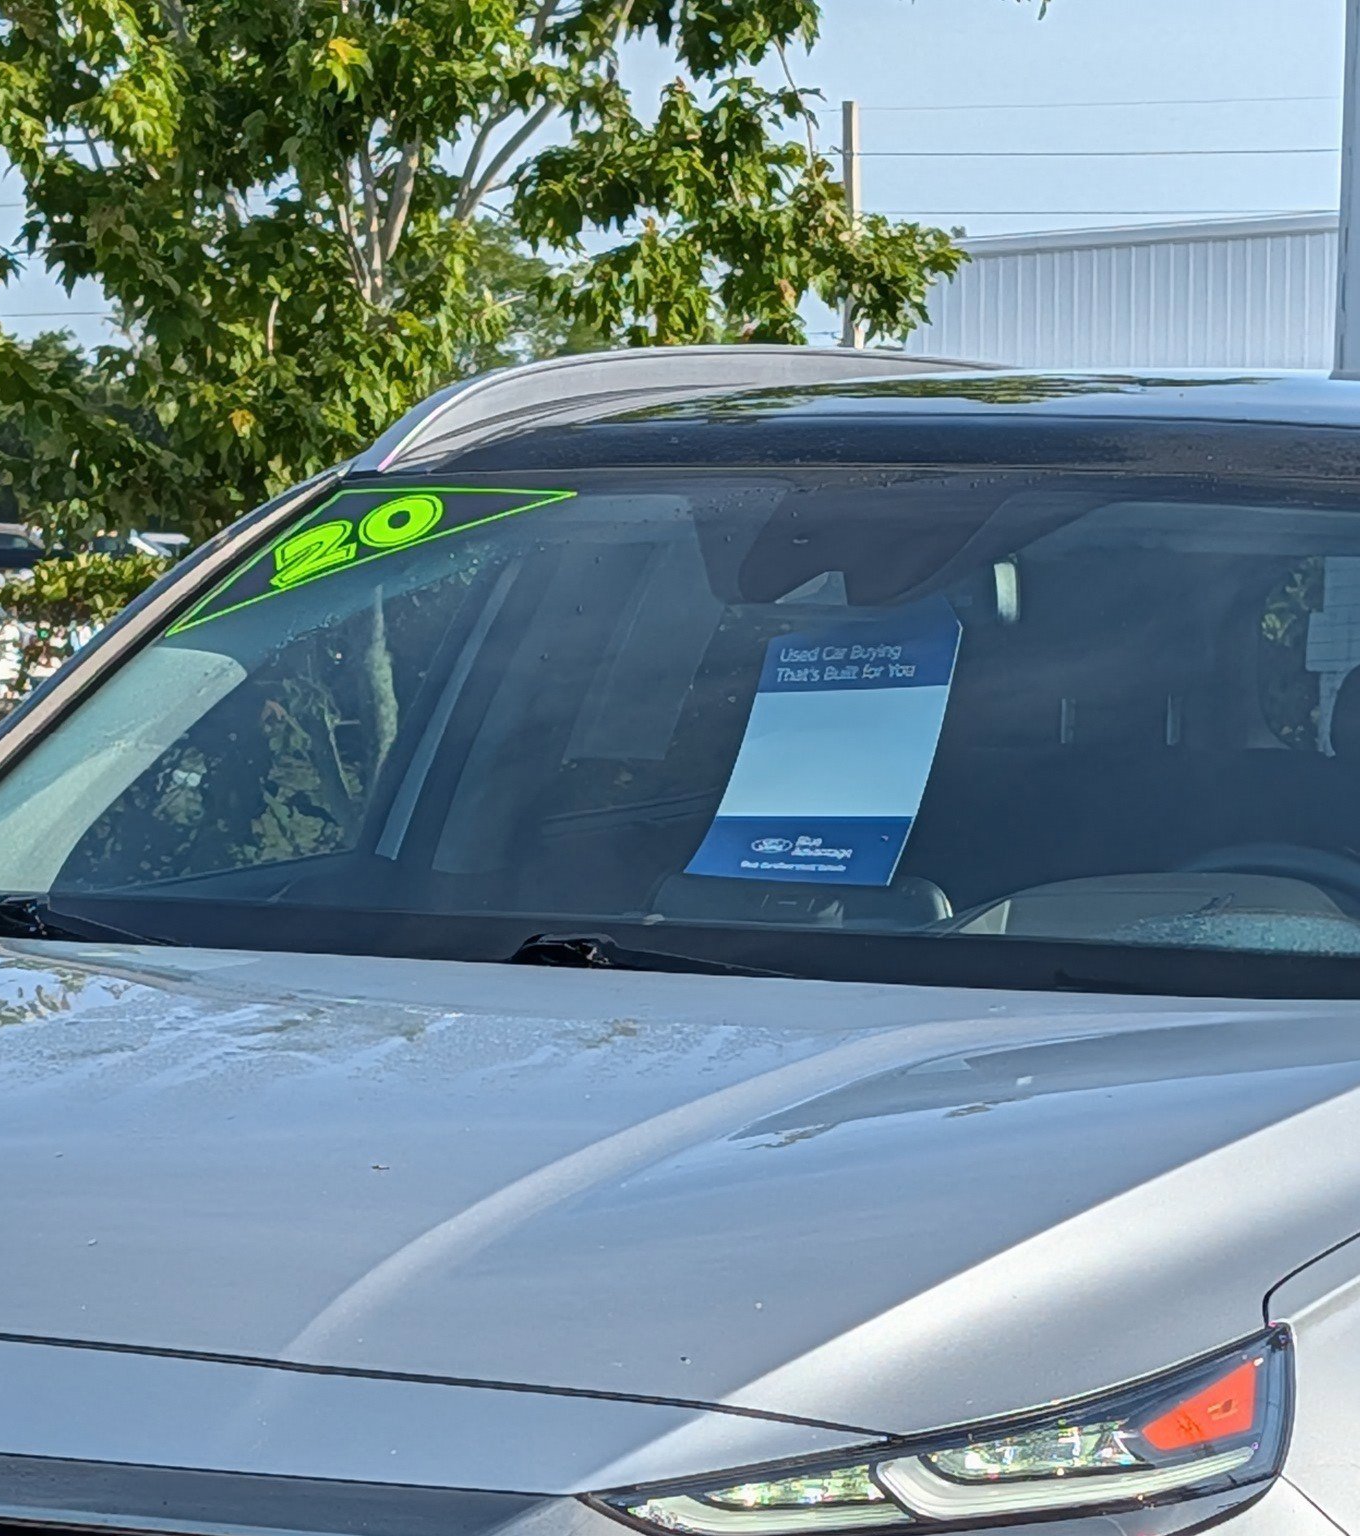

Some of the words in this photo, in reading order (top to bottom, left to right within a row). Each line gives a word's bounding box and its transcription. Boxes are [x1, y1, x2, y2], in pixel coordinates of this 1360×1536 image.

[269, 494, 444, 589] 20
[779, 646, 820, 662] Used
[822, 645, 848, 661] Car
[850, 643, 902, 662] Buying
[776, 667, 820, 682] That's
[823, 665, 859, 681] Built
[861, 663, 885, 680] for
[888, 663, 916, 678] You
